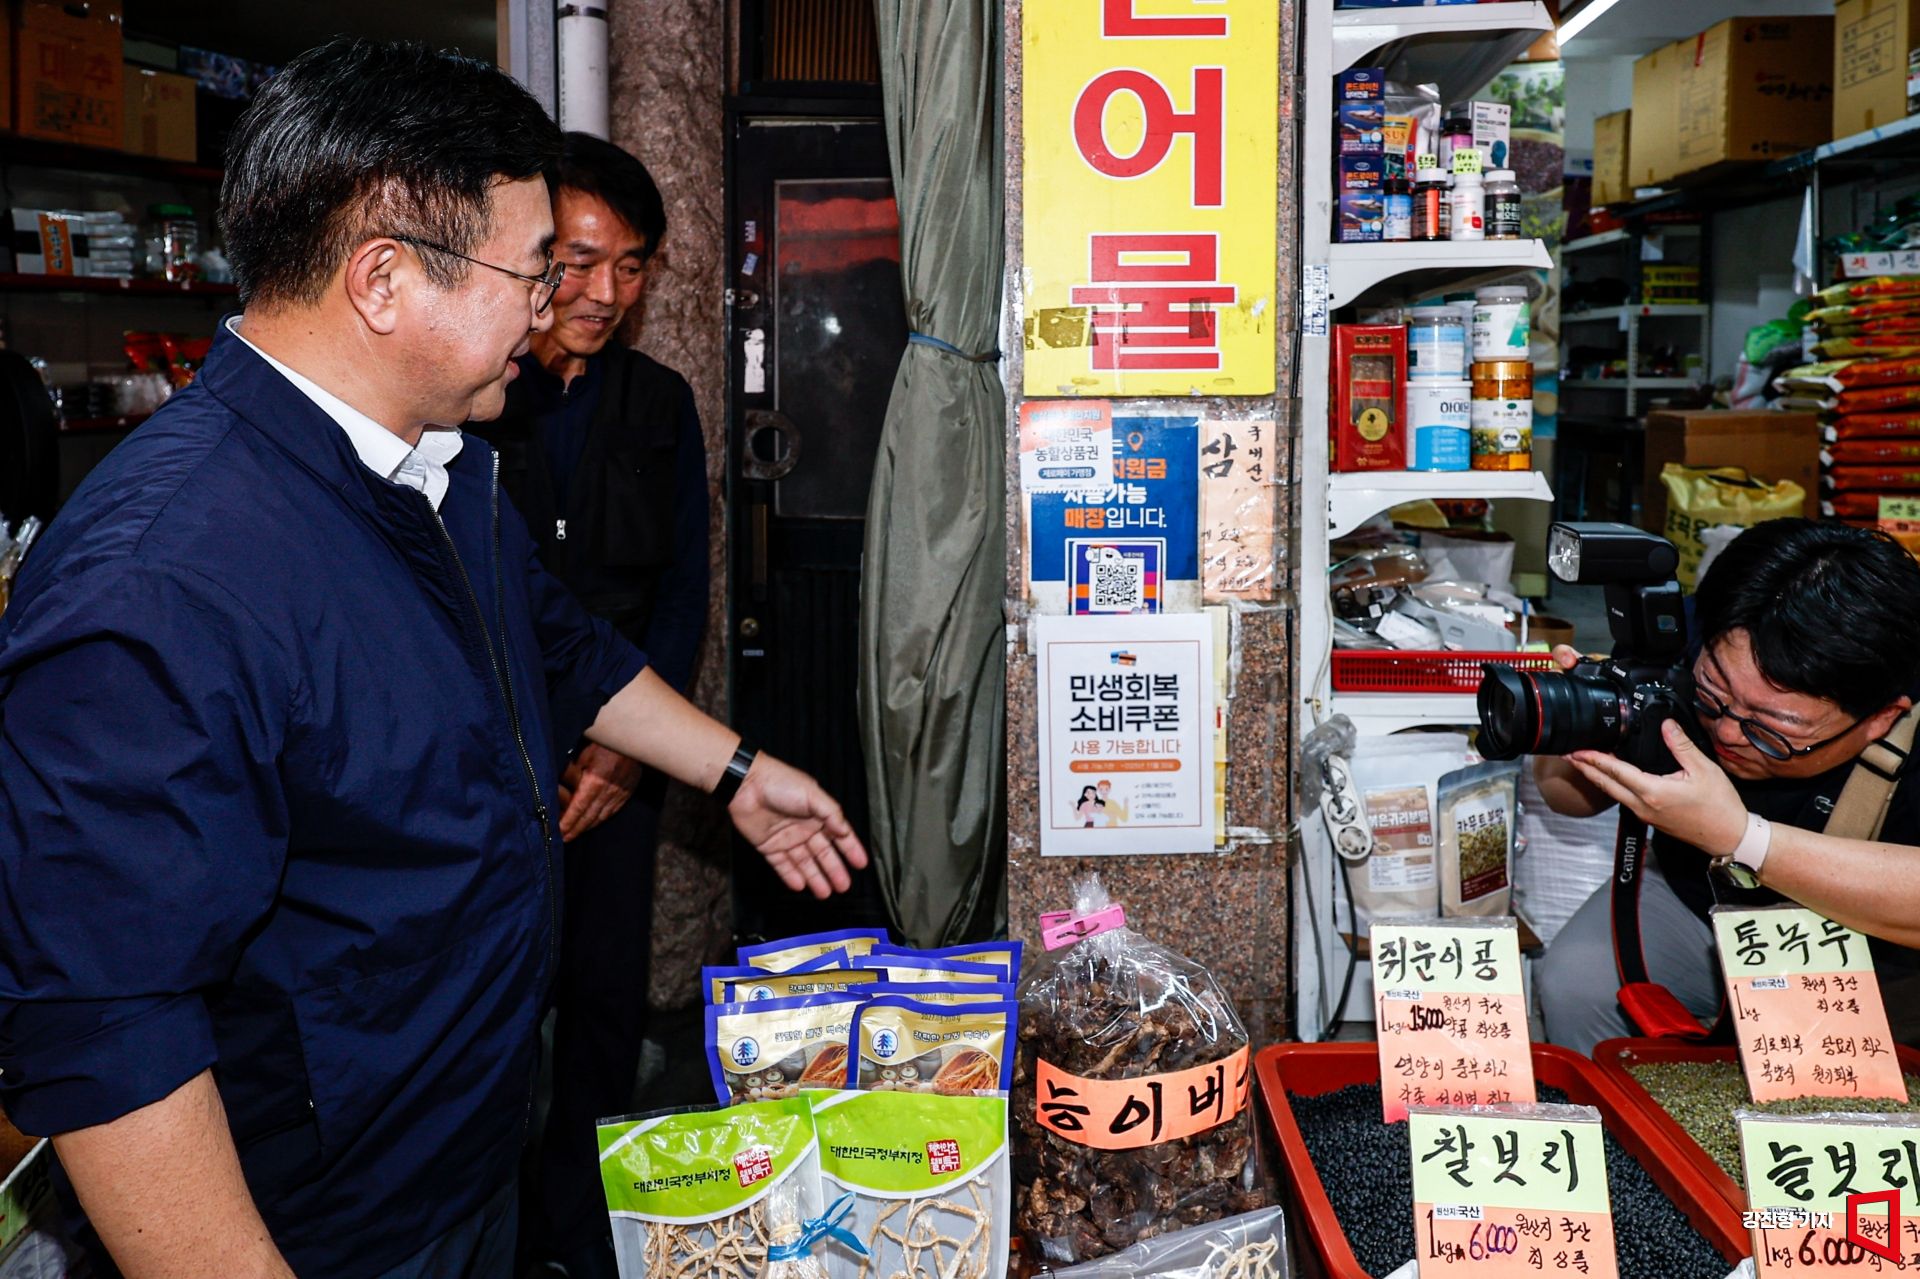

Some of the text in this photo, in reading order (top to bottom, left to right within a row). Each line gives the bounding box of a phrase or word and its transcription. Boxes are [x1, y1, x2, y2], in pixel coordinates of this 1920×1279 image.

[1064, 506, 1168, 529] 매장입니다.
[1069, 672, 1180, 703] 민생회복
[1069, 704, 1180, 733] 소비쿠폰
[1070, 738, 1182, 755] 사용 가능합니다
[1619, 835, 1637, 884] Canon
[1832, 975, 1859, 992] 국산
[829, 1145, 923, 1165] 대한민국정부지정
[633, 1167, 731, 1194] 대한민국정부지정
[1559, 1216, 1592, 1243] 국산
[1903, 1219, 1920, 1243] 국
